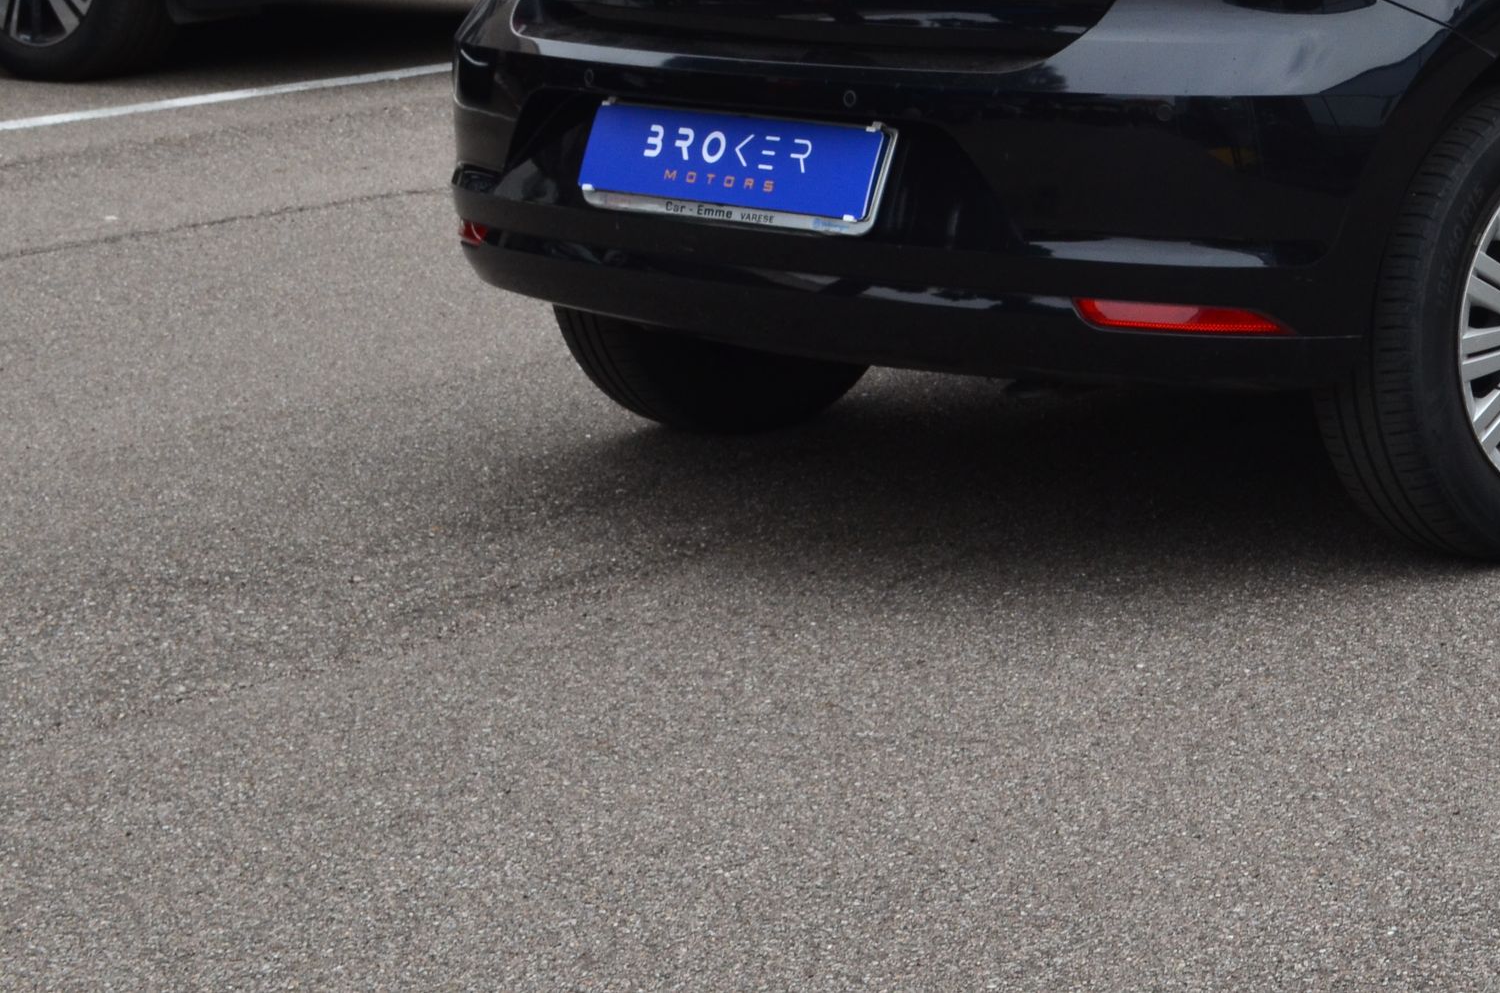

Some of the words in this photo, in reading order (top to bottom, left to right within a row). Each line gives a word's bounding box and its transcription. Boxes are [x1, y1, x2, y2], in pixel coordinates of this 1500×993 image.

[643, 124, 813, 174] BROKER
[664, 169, 775, 193] MOTORS
[665, 201, 686, 213] Car
[696, 204, 733, 219] Emme
[739, 212, 776, 224] VARESE
